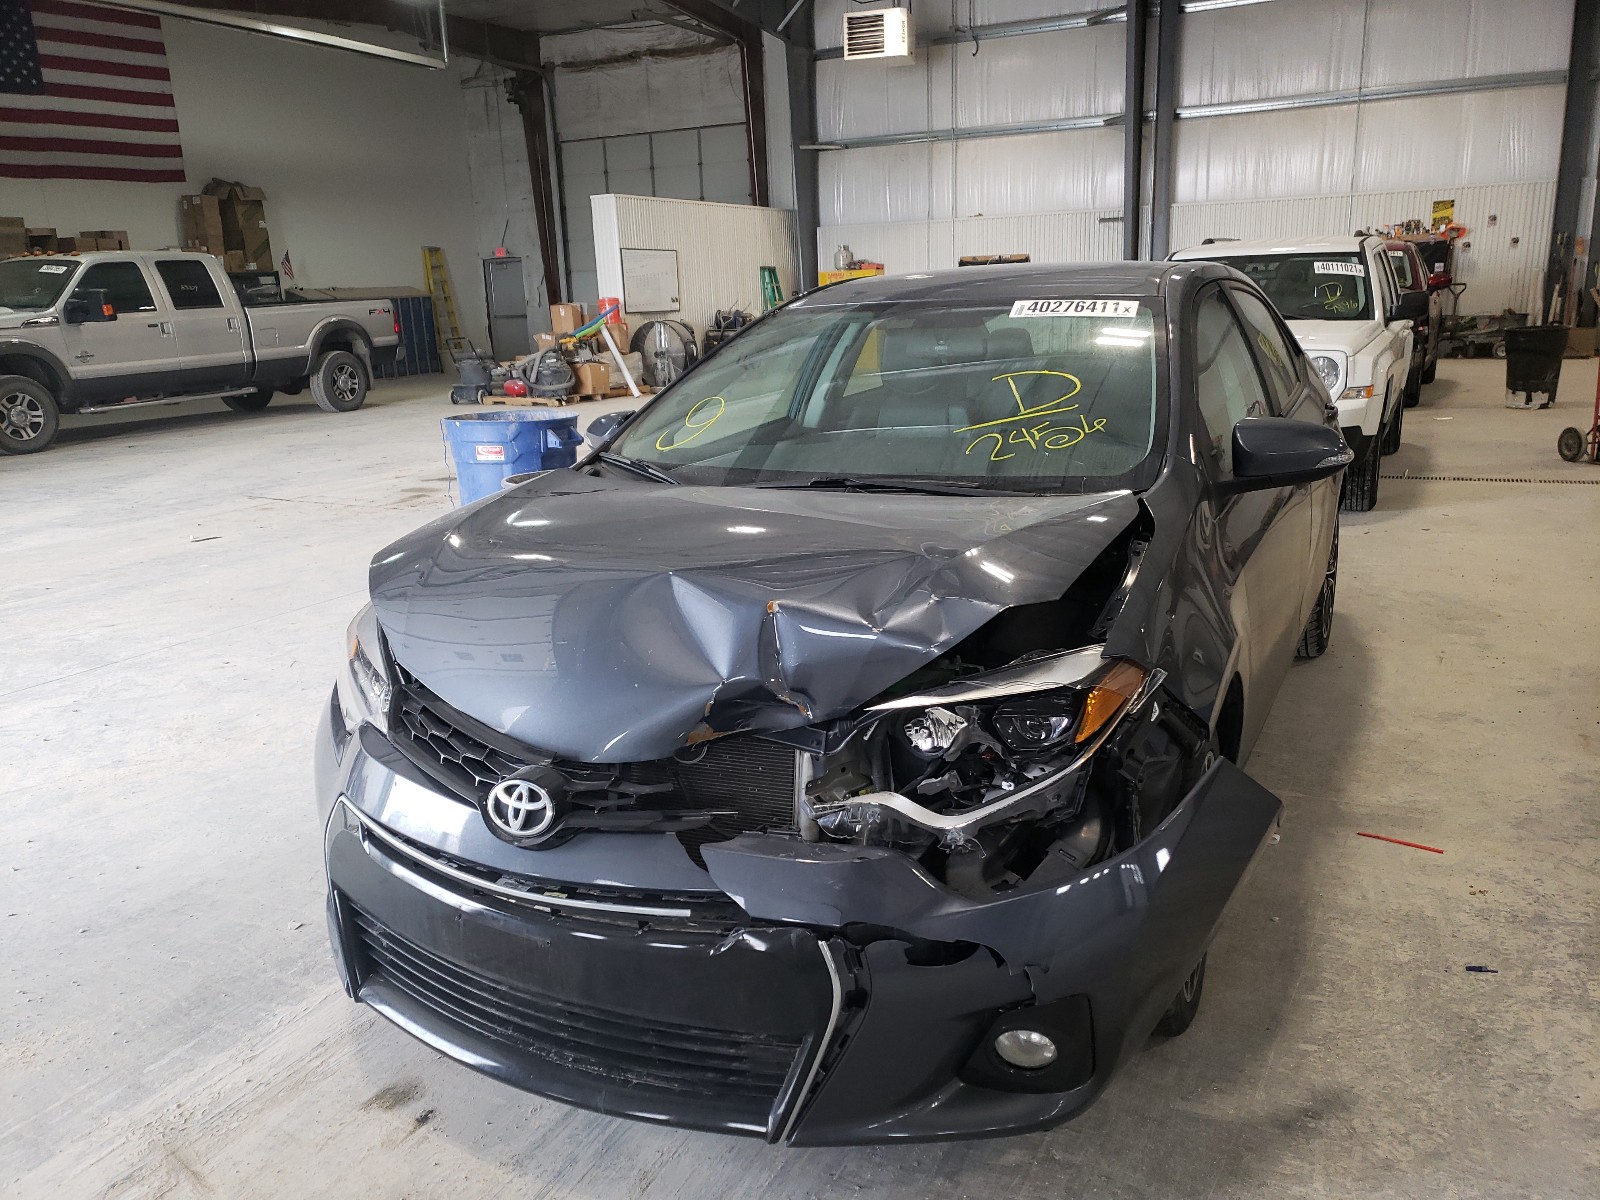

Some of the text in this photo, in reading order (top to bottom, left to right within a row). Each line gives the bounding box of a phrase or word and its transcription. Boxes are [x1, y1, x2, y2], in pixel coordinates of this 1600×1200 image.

[368, 308, 391, 316] FX4
[1027, 301, 1120, 313] 40276411
[992, 370, 1082, 415] D
